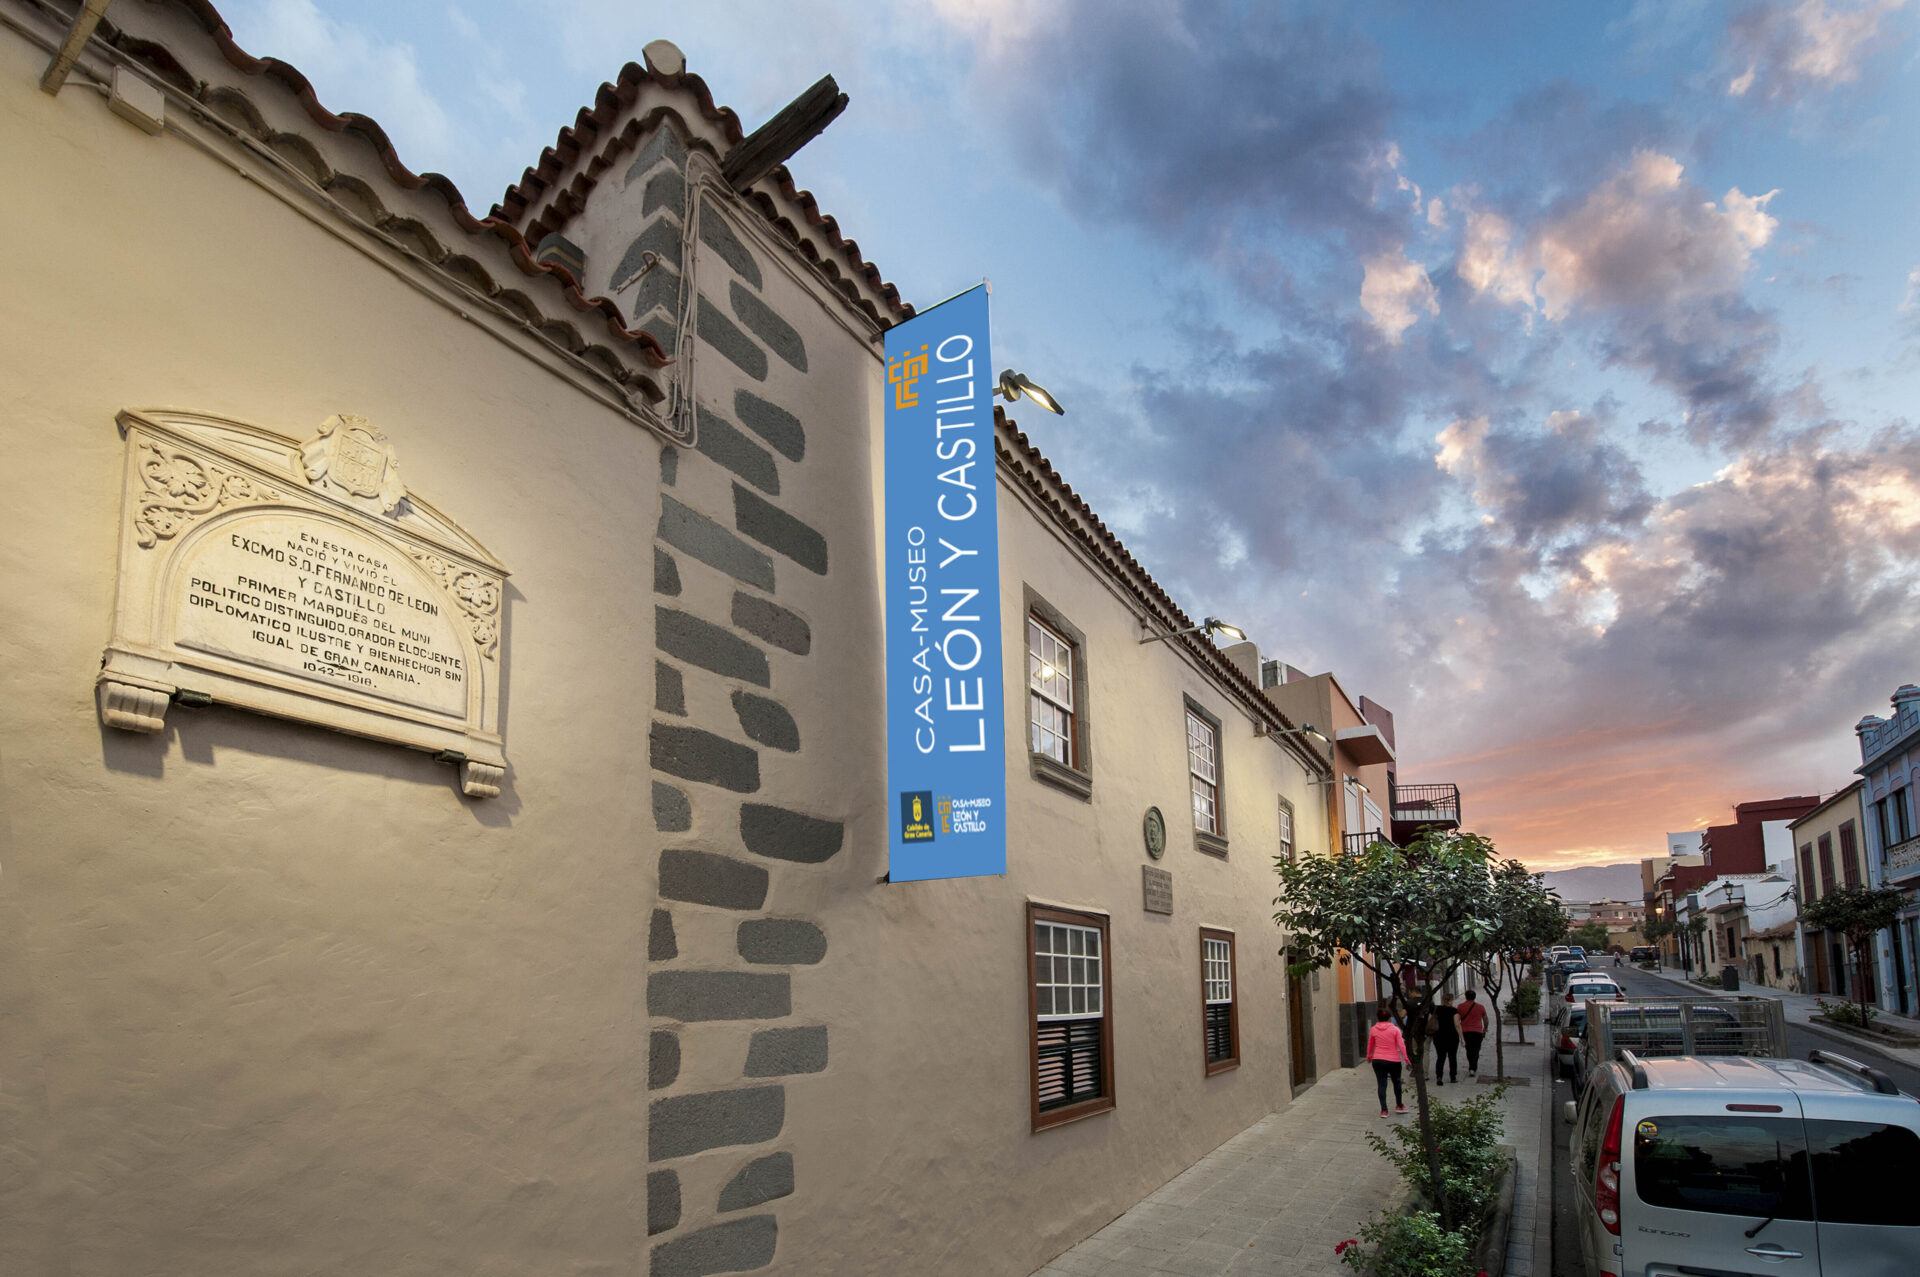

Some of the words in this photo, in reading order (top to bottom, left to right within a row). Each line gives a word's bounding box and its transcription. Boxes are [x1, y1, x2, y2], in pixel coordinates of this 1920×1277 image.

[936, 334, 978, 521] CASTILLO
[287, 540, 327, 561] NACIÓ
[332, 557, 339, 565] Y
[344, 560, 378, 580] VIVIÓ
[383, 575, 398, 587] EL
[301, 533, 318, 546] EN
[323, 542, 354, 559] ESTA
[357, 554, 388, 571] CASA
[938, 537, 978, 569] Y
[191, 577, 261, 608] POLITICO
[231, 534, 284, 563] EXCMO
[388, 589, 404, 605] DE
[407, 596, 438, 617] LEON
[238, 576, 297, 603] PRIMER
[303, 596, 368, 625] MARQUÉS
[373, 619, 396, 634] DEL
[401, 627, 431, 645] MUNI
[298, 576, 307, 589] Y
[313, 581, 386, 615] CASTILLO
[189, 593, 291, 633] DIPLOMATICO
[297, 626, 351, 651] ILUSTRE
[356, 643, 364, 654] Y
[369, 647, 441, 677] BIENHECHOR
[445, 670, 462, 683] SIN
[252, 629, 294, 651] IGUAL
[300, 643, 318, 657] DE
[324, 650, 359, 669] GRAN
[363, 661, 421, 685] CANARIA.
[907, 526, 935, 754] CASA-MUSEO
[934, 588, 986, 752] LEÓN
[952, 798, 991, 808] CASA-MUSEO
[953, 809, 972, 822] LEÓN
[973, 810, 979, 820] Y
[904, 831, 915, 839] Gran
[916, 830, 933, 838] Canaria
[906, 823, 923, 831] Cabildo
[953, 820, 986, 833] CASTILLO
